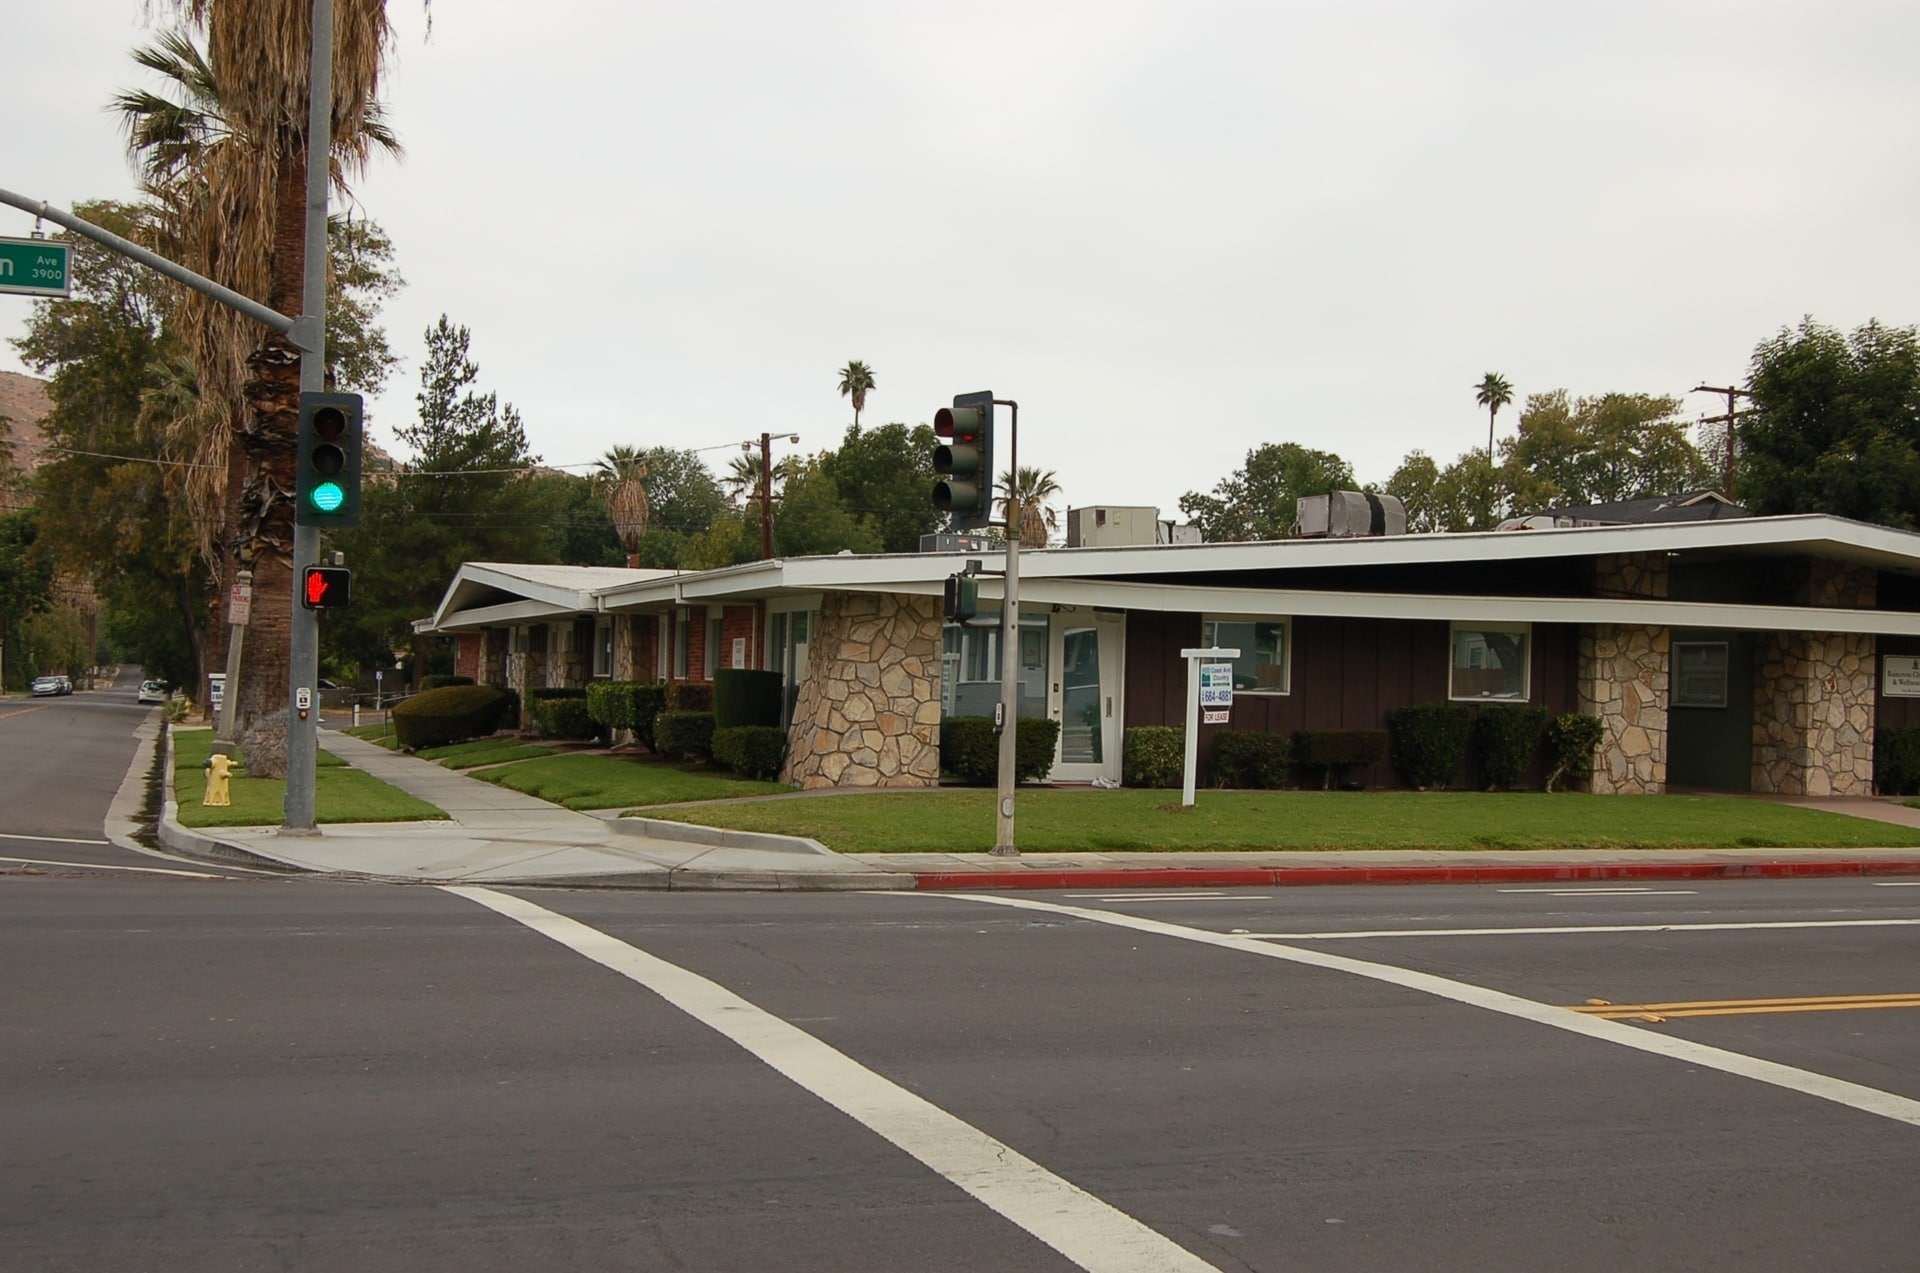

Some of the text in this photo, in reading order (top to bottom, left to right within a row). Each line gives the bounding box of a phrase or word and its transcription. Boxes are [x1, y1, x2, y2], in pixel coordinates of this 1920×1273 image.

[37, 255, 58, 266] Ave
[32, 268, 63, 280] 3900
[1205, 712, 1228, 721] FOR LEASE
